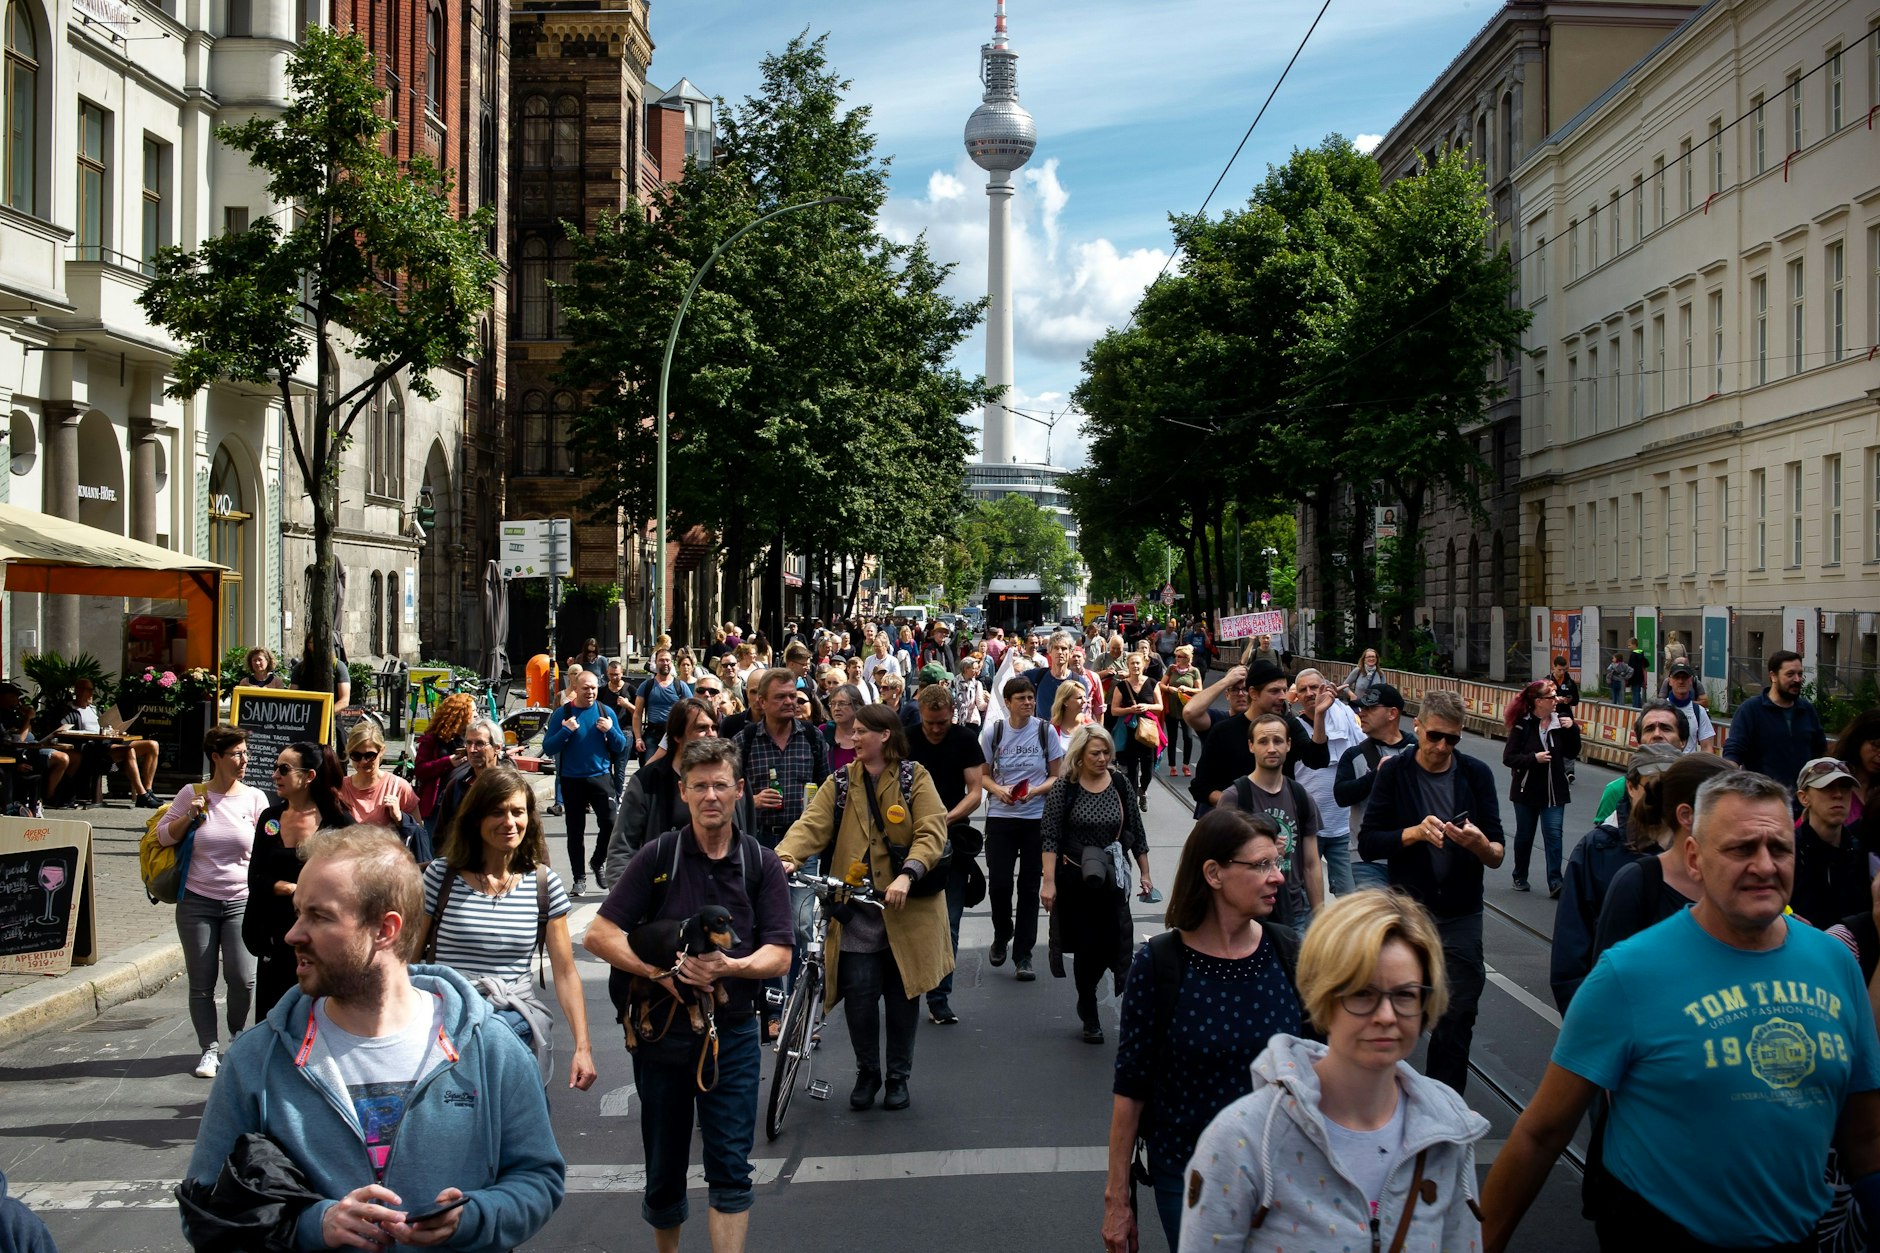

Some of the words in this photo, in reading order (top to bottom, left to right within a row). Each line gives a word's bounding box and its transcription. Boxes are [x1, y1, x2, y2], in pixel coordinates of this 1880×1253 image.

[78, 485, 114, 502] KMANN-HÖFE
[1235, 616, 1250, 624] GIBT
[1235, 622, 1251, 630] MUSS
[1224, 630, 1236, 638] MAL
[1237, 628, 1252, 637] NEIN
[242, 701, 311, 723] SANDWICH
[24, 828, 51, 839] APEROL
[15, 950, 65, 963] APERITIVO
[28, 959, 49, 968] 1919
[1684, 985, 1749, 1027] TOM
[1751, 980, 1842, 1020] TAILOR
[1708, 1010, 1748, 1030] URBAN
[1752, 1005, 1804, 1017] FASHION
[1807, 1007, 1832, 1023] GEAR
